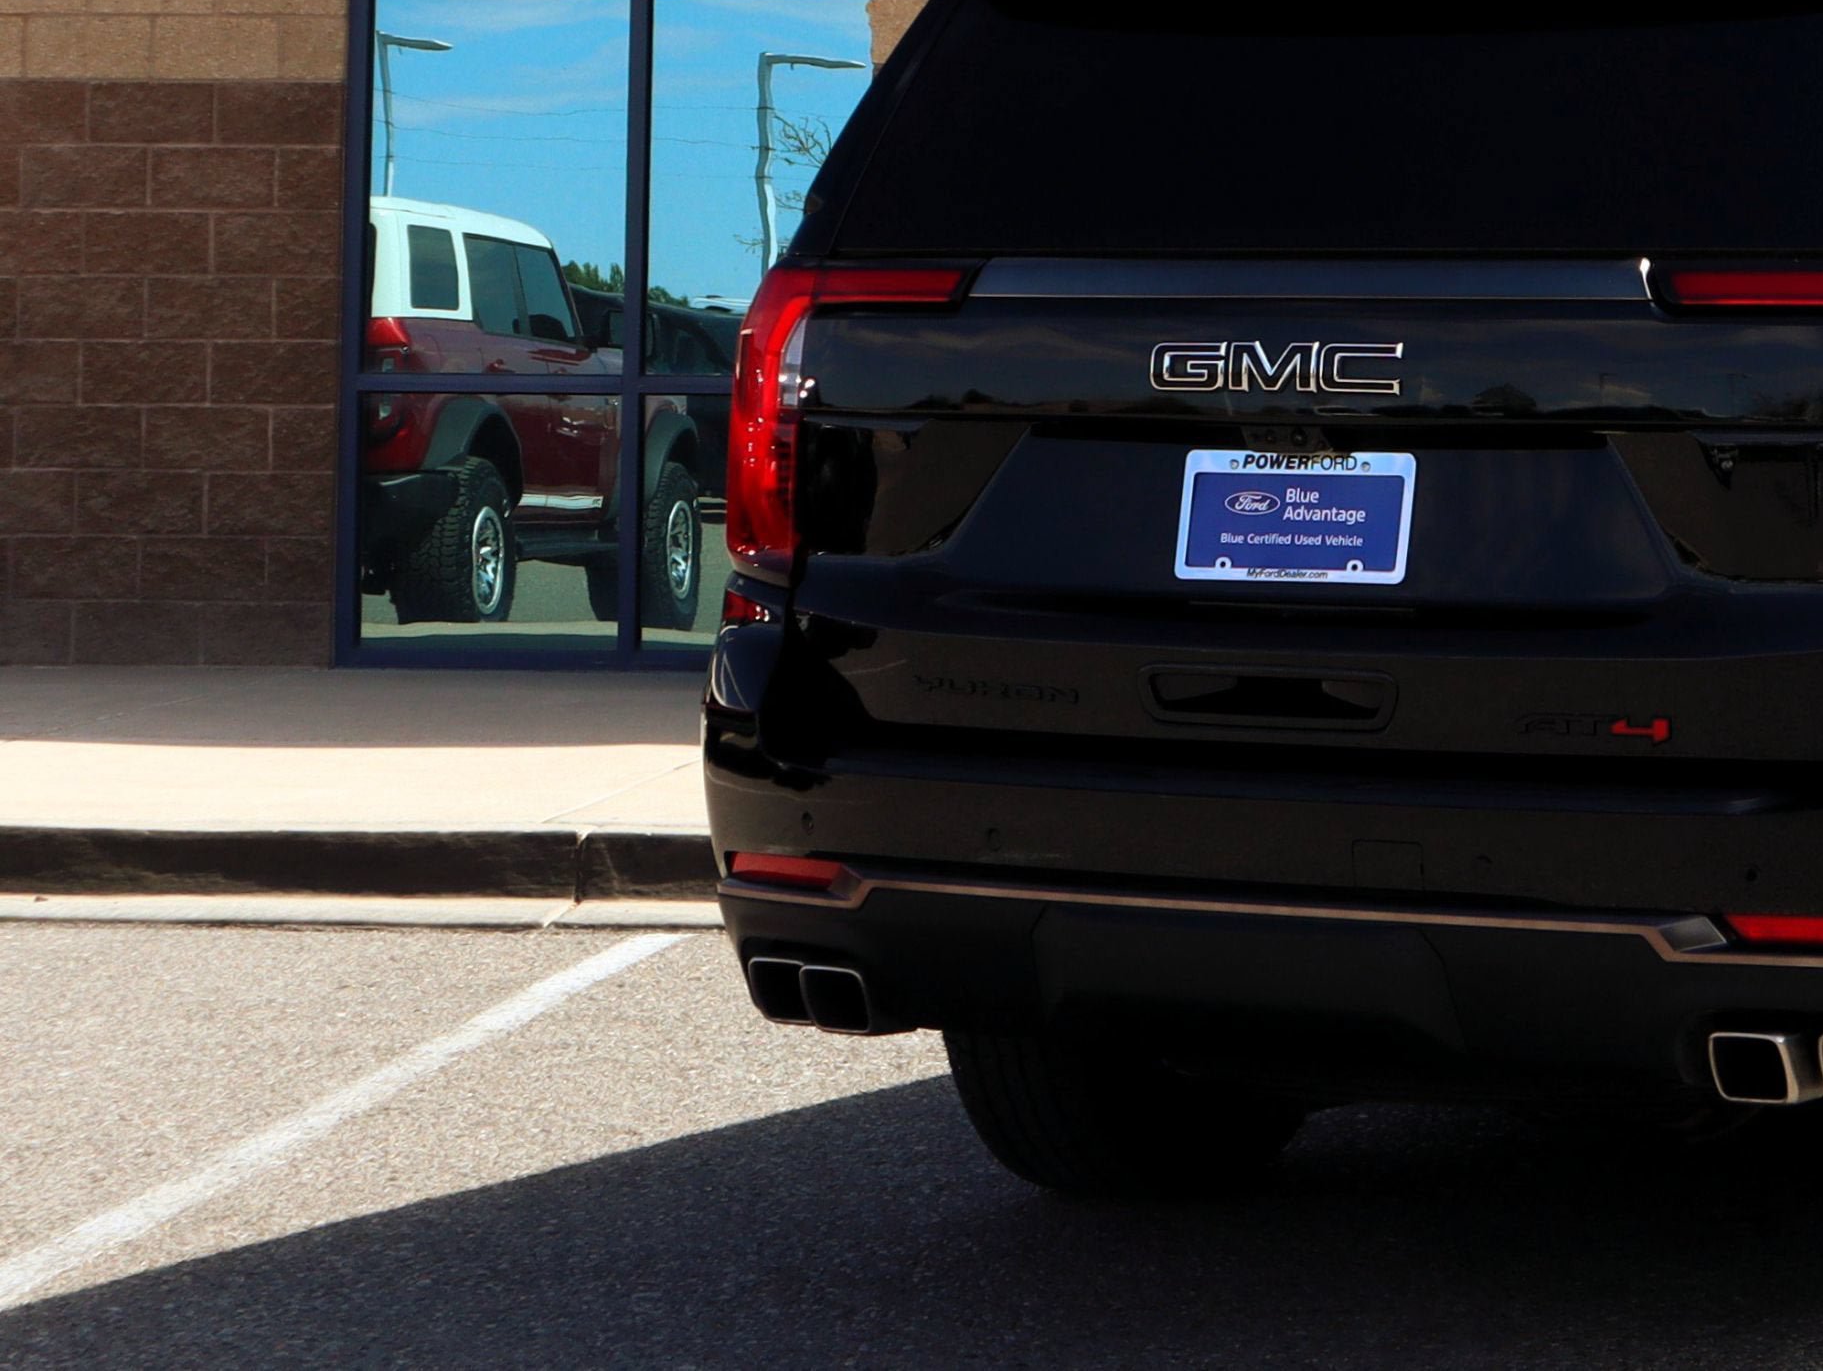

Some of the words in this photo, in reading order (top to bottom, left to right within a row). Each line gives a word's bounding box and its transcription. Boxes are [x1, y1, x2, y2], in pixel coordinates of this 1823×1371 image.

[1150, 340, 1404, 396] GMC
[1234, 494, 1272, 511] Ford
[1285, 487, 1320, 504] Blue
[1282, 505, 1366, 524] Advantage
[1220, 532, 1243, 544] Blue
[1247, 532, 1291, 546] Certified
[1294, 533, 1322, 546] Used
[1325, 534, 1364, 547] Vehicle
[1246, 567, 1329, 580] MyFordDealer.com
[1515, 712, 1673, 747] AT4
